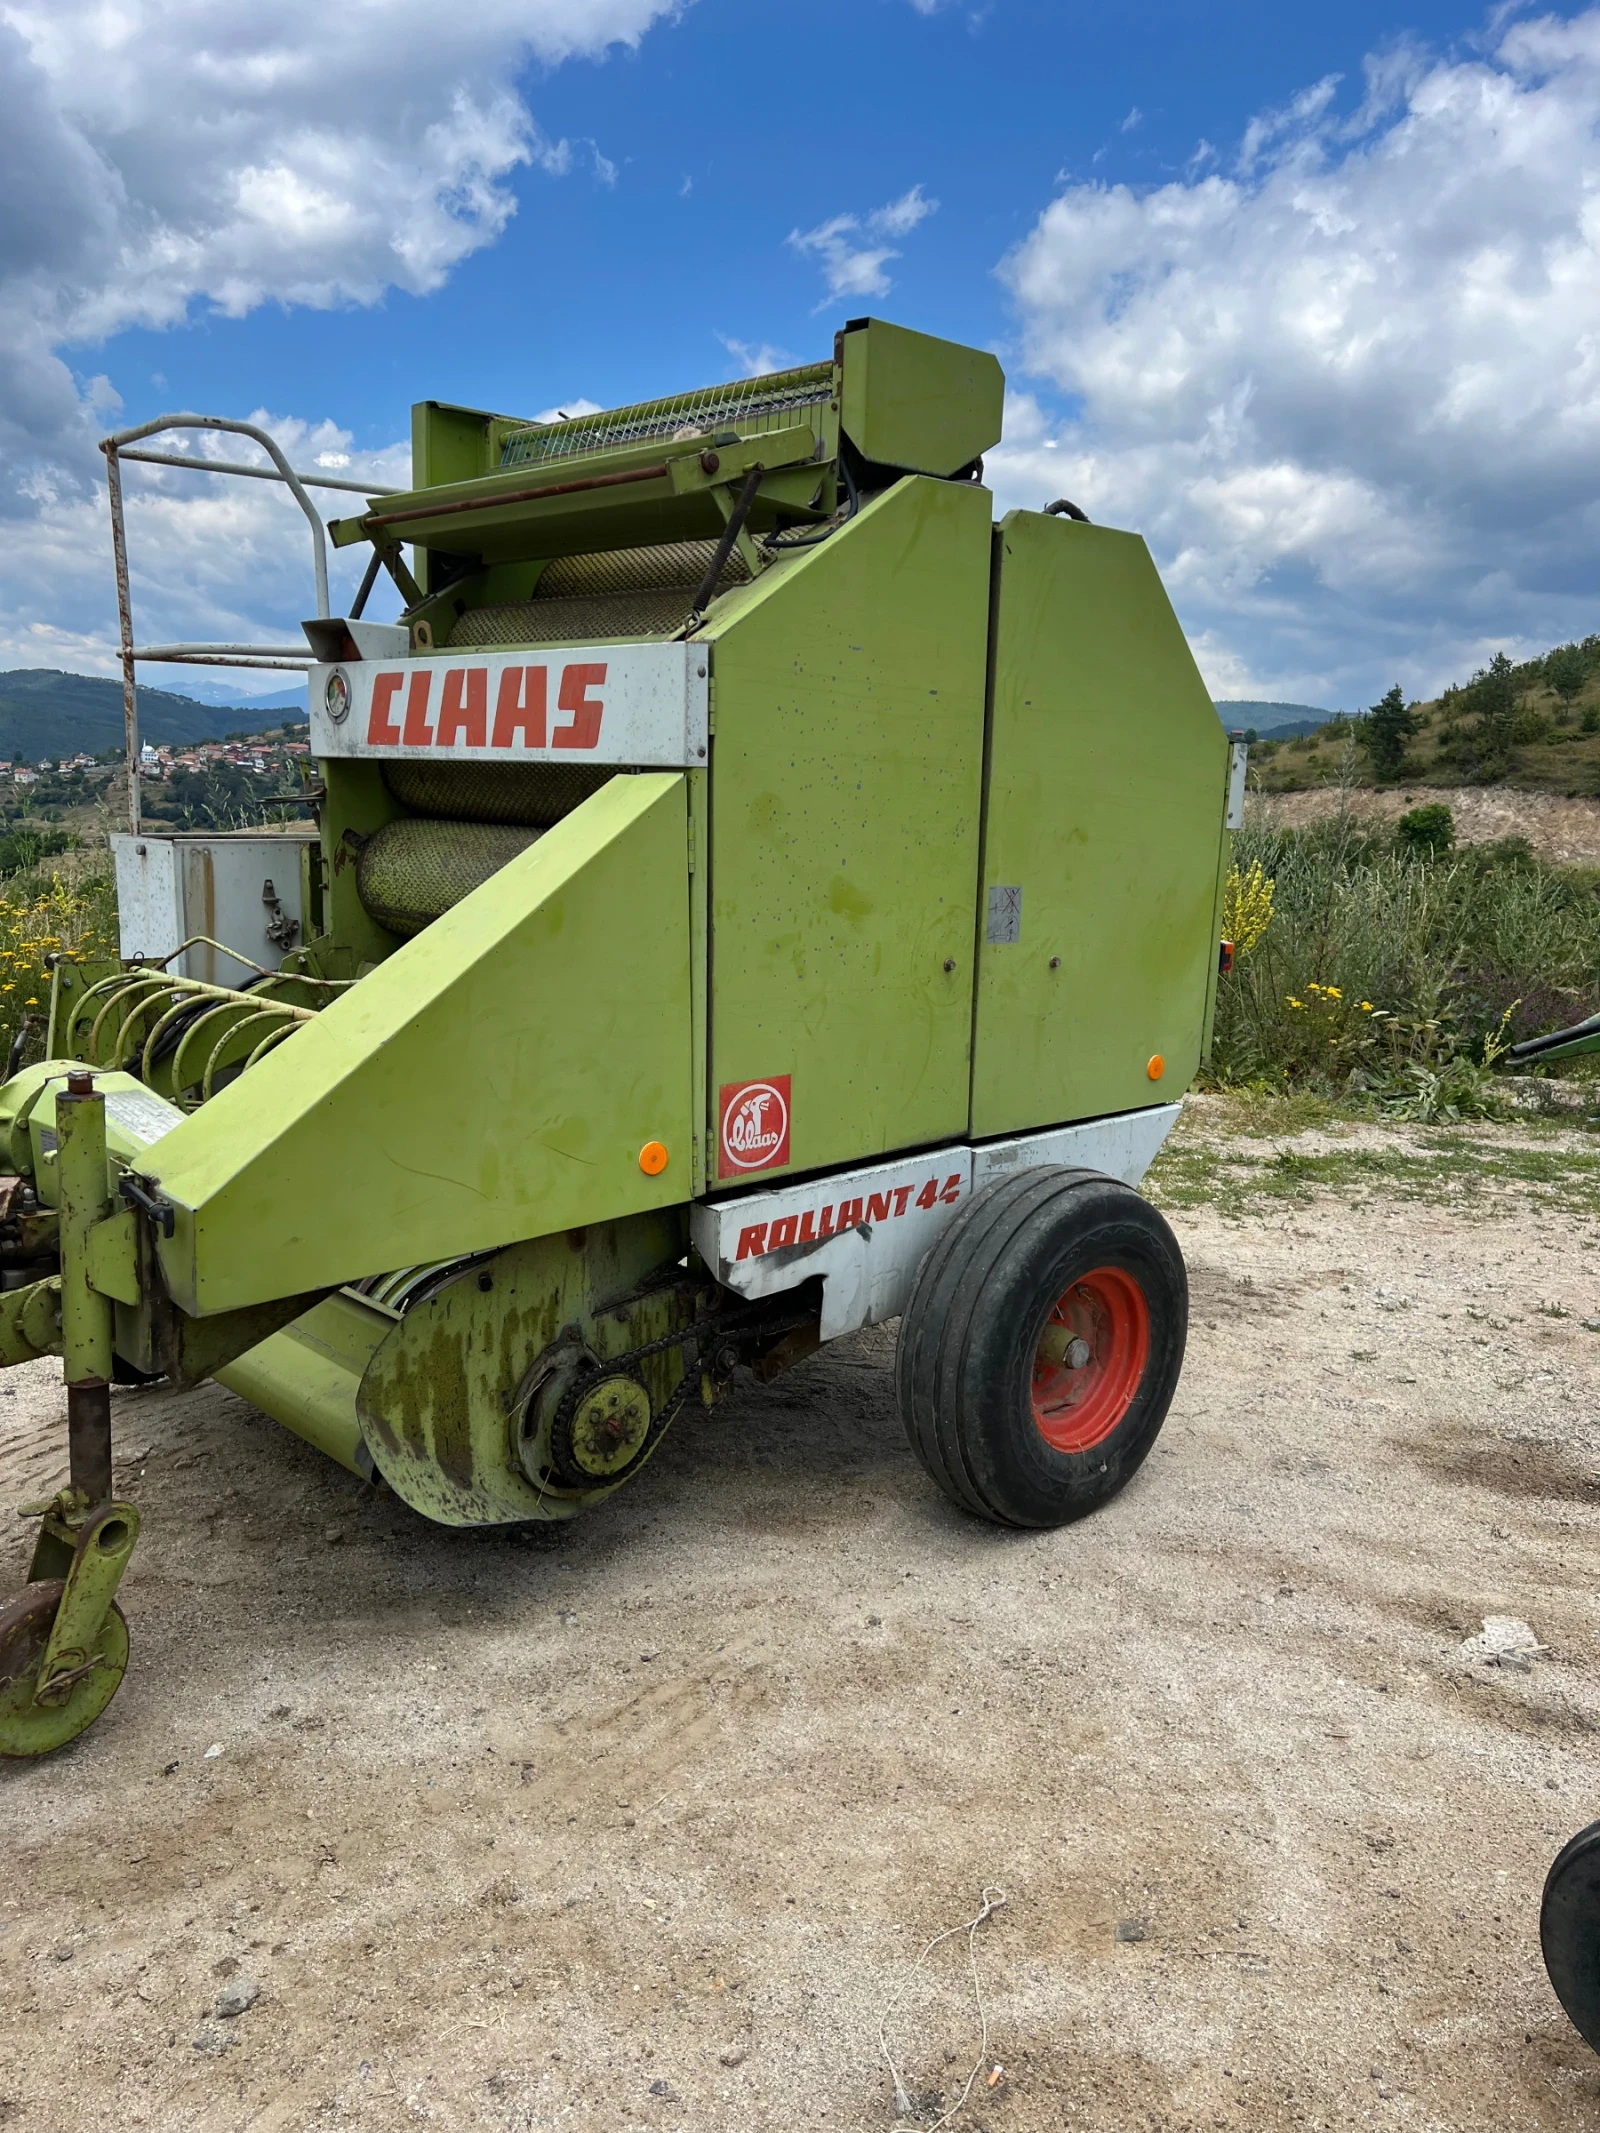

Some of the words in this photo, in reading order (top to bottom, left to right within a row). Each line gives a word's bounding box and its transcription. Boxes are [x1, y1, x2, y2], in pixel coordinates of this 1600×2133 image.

[367, 663, 607, 748] CLAAS
[729, 1114, 778, 1151] Claas
[736, 1184, 915, 1261] ROLLANT
[915, 1173, 961, 1210] 44
